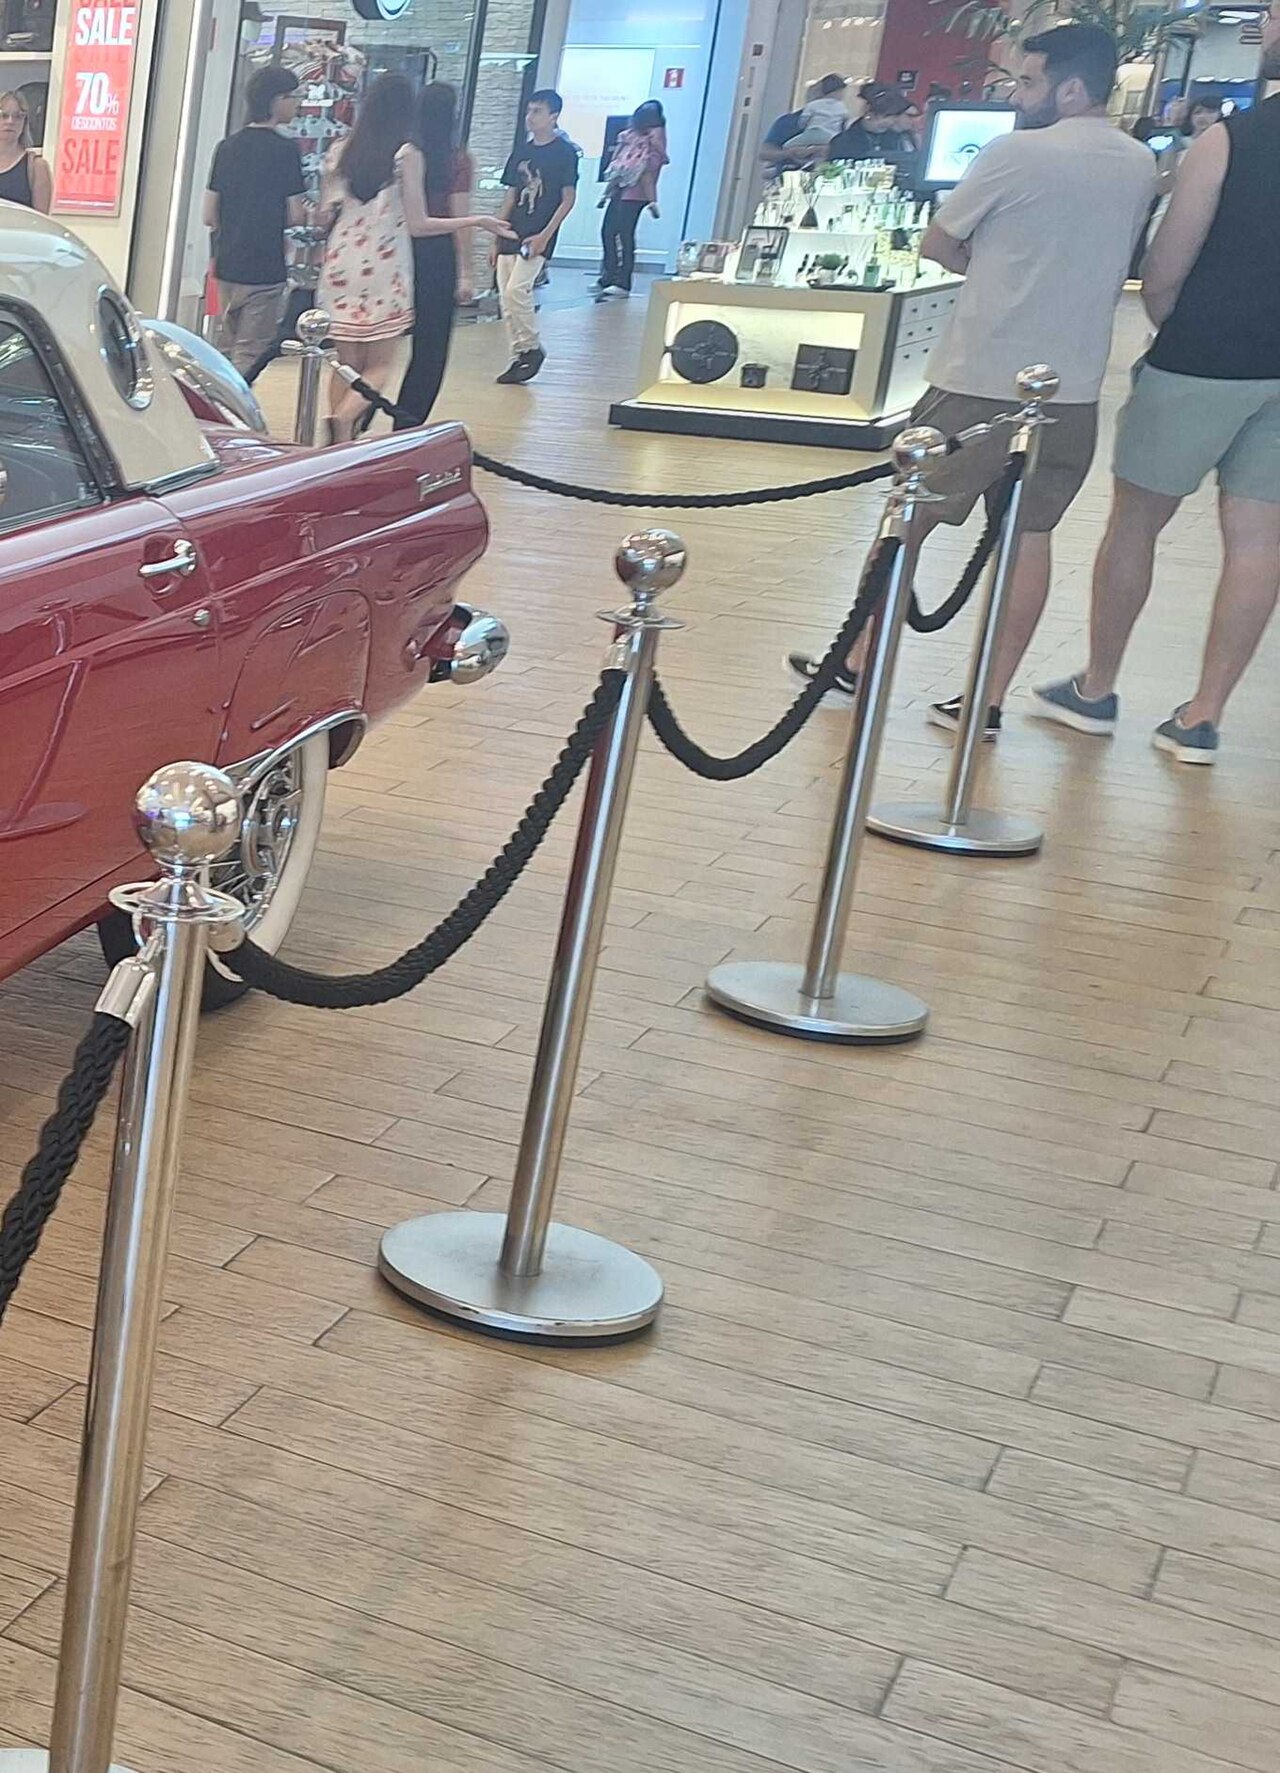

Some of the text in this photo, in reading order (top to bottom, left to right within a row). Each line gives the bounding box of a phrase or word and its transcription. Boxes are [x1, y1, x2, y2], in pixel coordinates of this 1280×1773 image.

[75, 7, 136, 46] SALE
[74, 71, 120, 116] 70%
[62, 138, 120, 175] SALE
